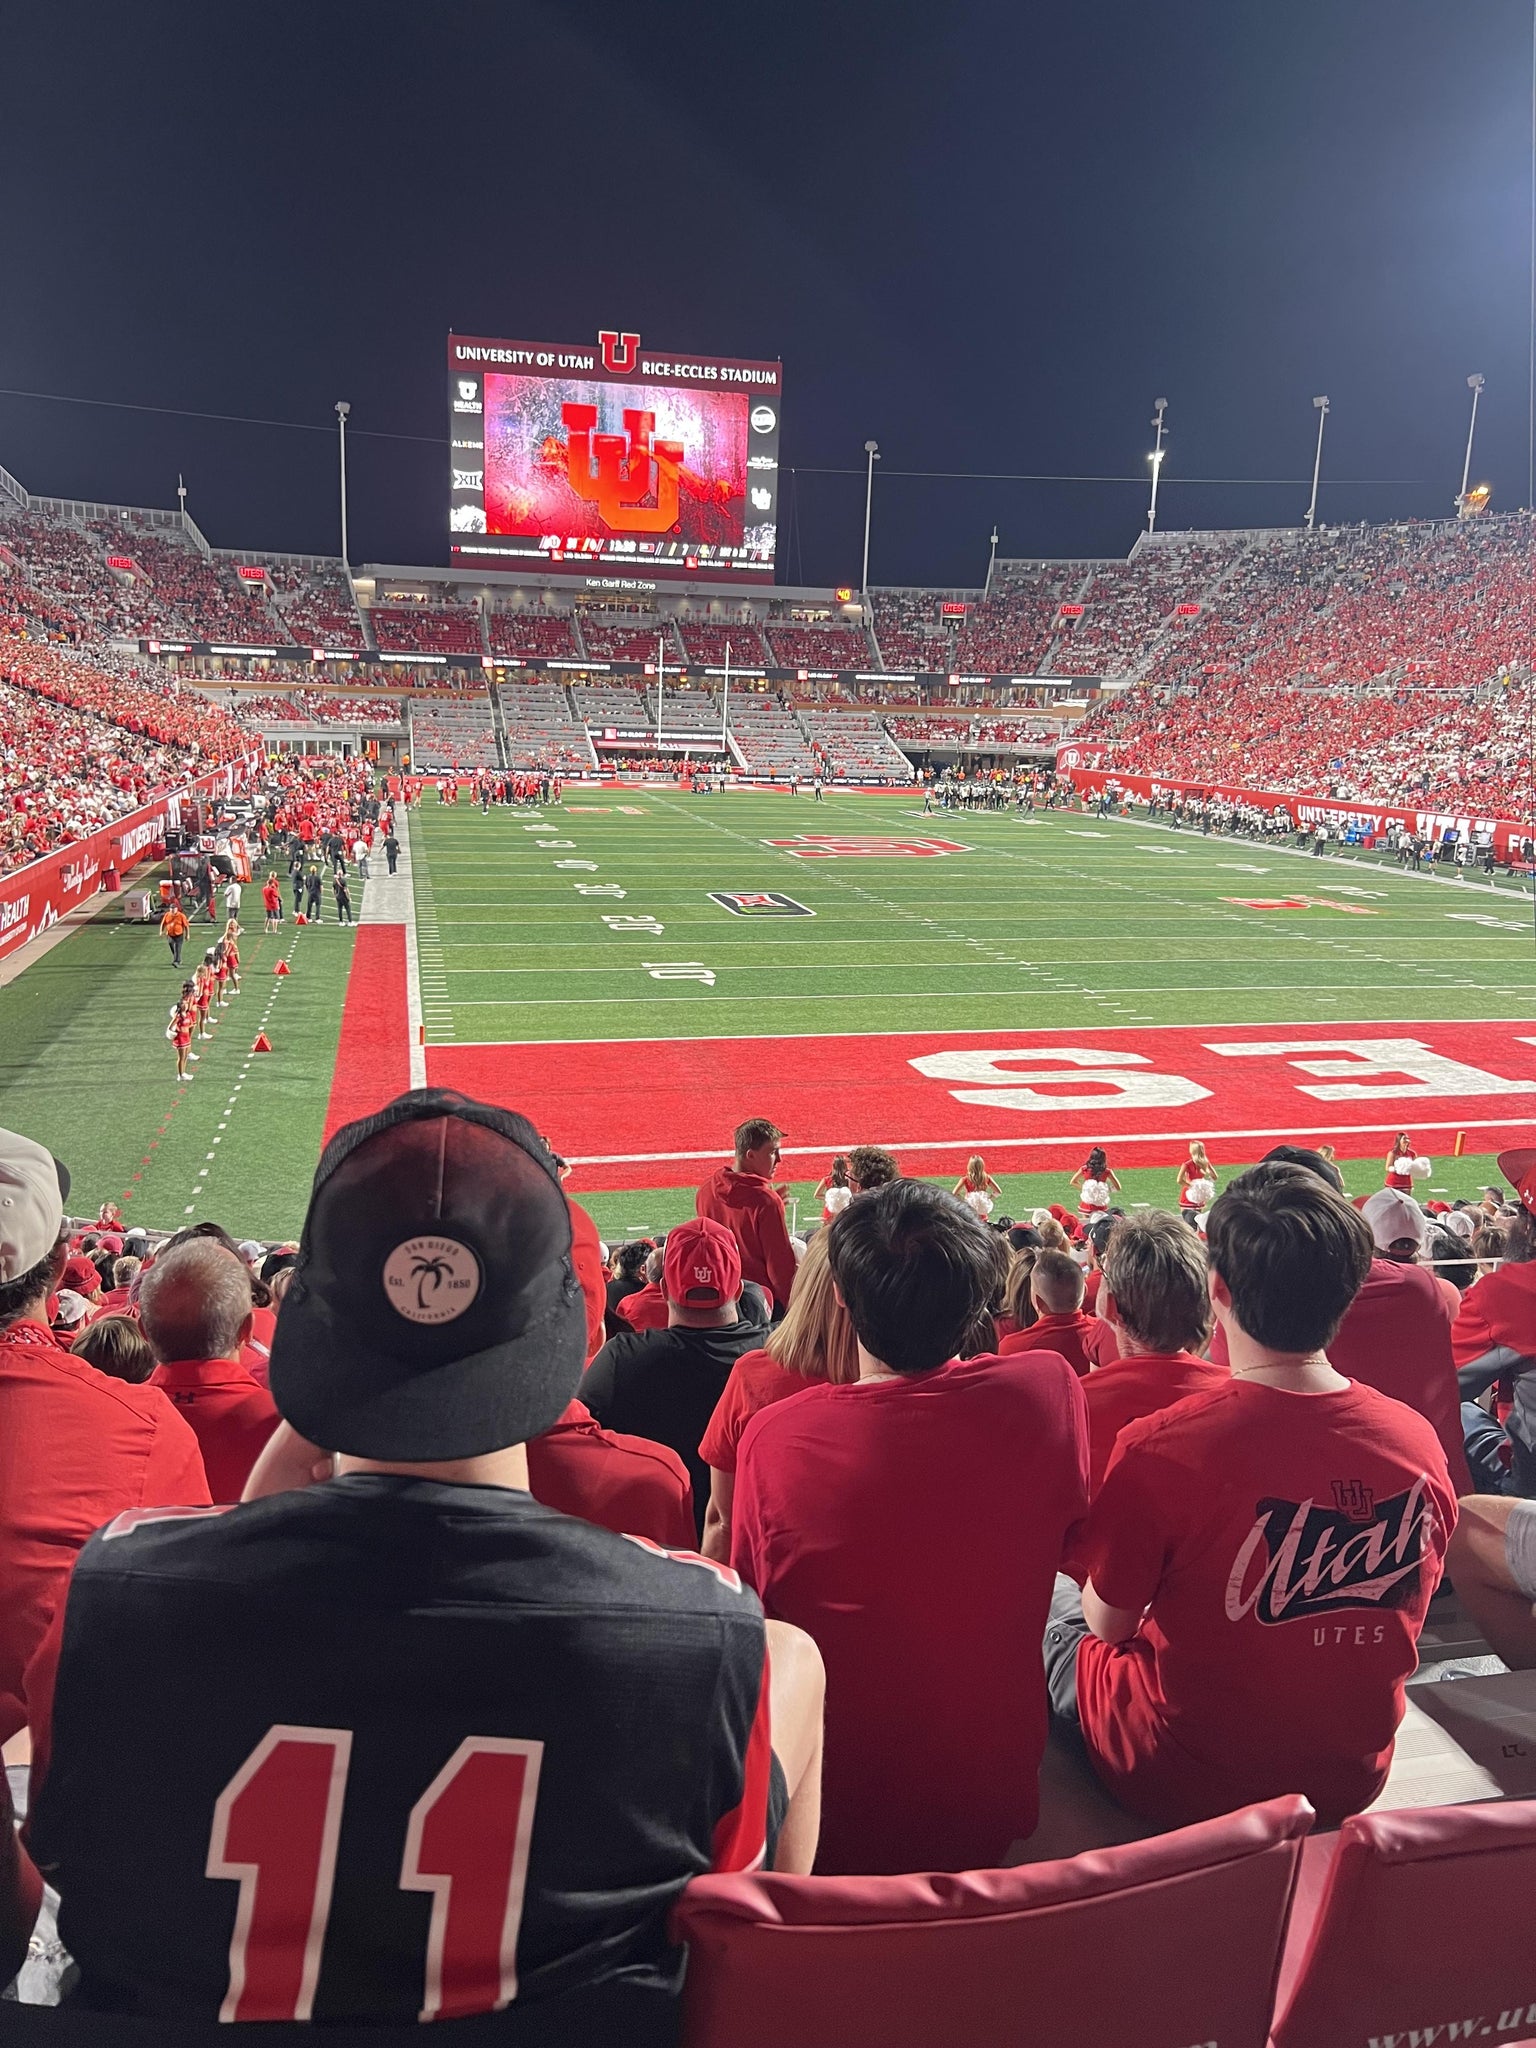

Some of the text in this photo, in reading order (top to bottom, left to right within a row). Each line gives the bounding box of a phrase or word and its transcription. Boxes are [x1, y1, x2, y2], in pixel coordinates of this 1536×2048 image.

[456, 346, 594, 370] UNIVERSITY OF UTAH
[598, 330, 641, 374] U
[642, 361, 777, 385] RICE-ECCLES STADIUM
[108, 556, 132, 568] UTES!
[240, 567, 264, 578] UTES!
[586, 578, 600, 587] Ken
[621, 580, 637, 588] Red
[637, 581, 656, 590] Zone
[836, 589, 851, 601] 40
[943, 603, 965, 613] UTES!
[641, 961, 717, 979] 10
[1225, 1472, 1434, 1622] Utah
[1313, 1625, 1385, 1647] UTES
[206, 1724, 544, 2024] 11
